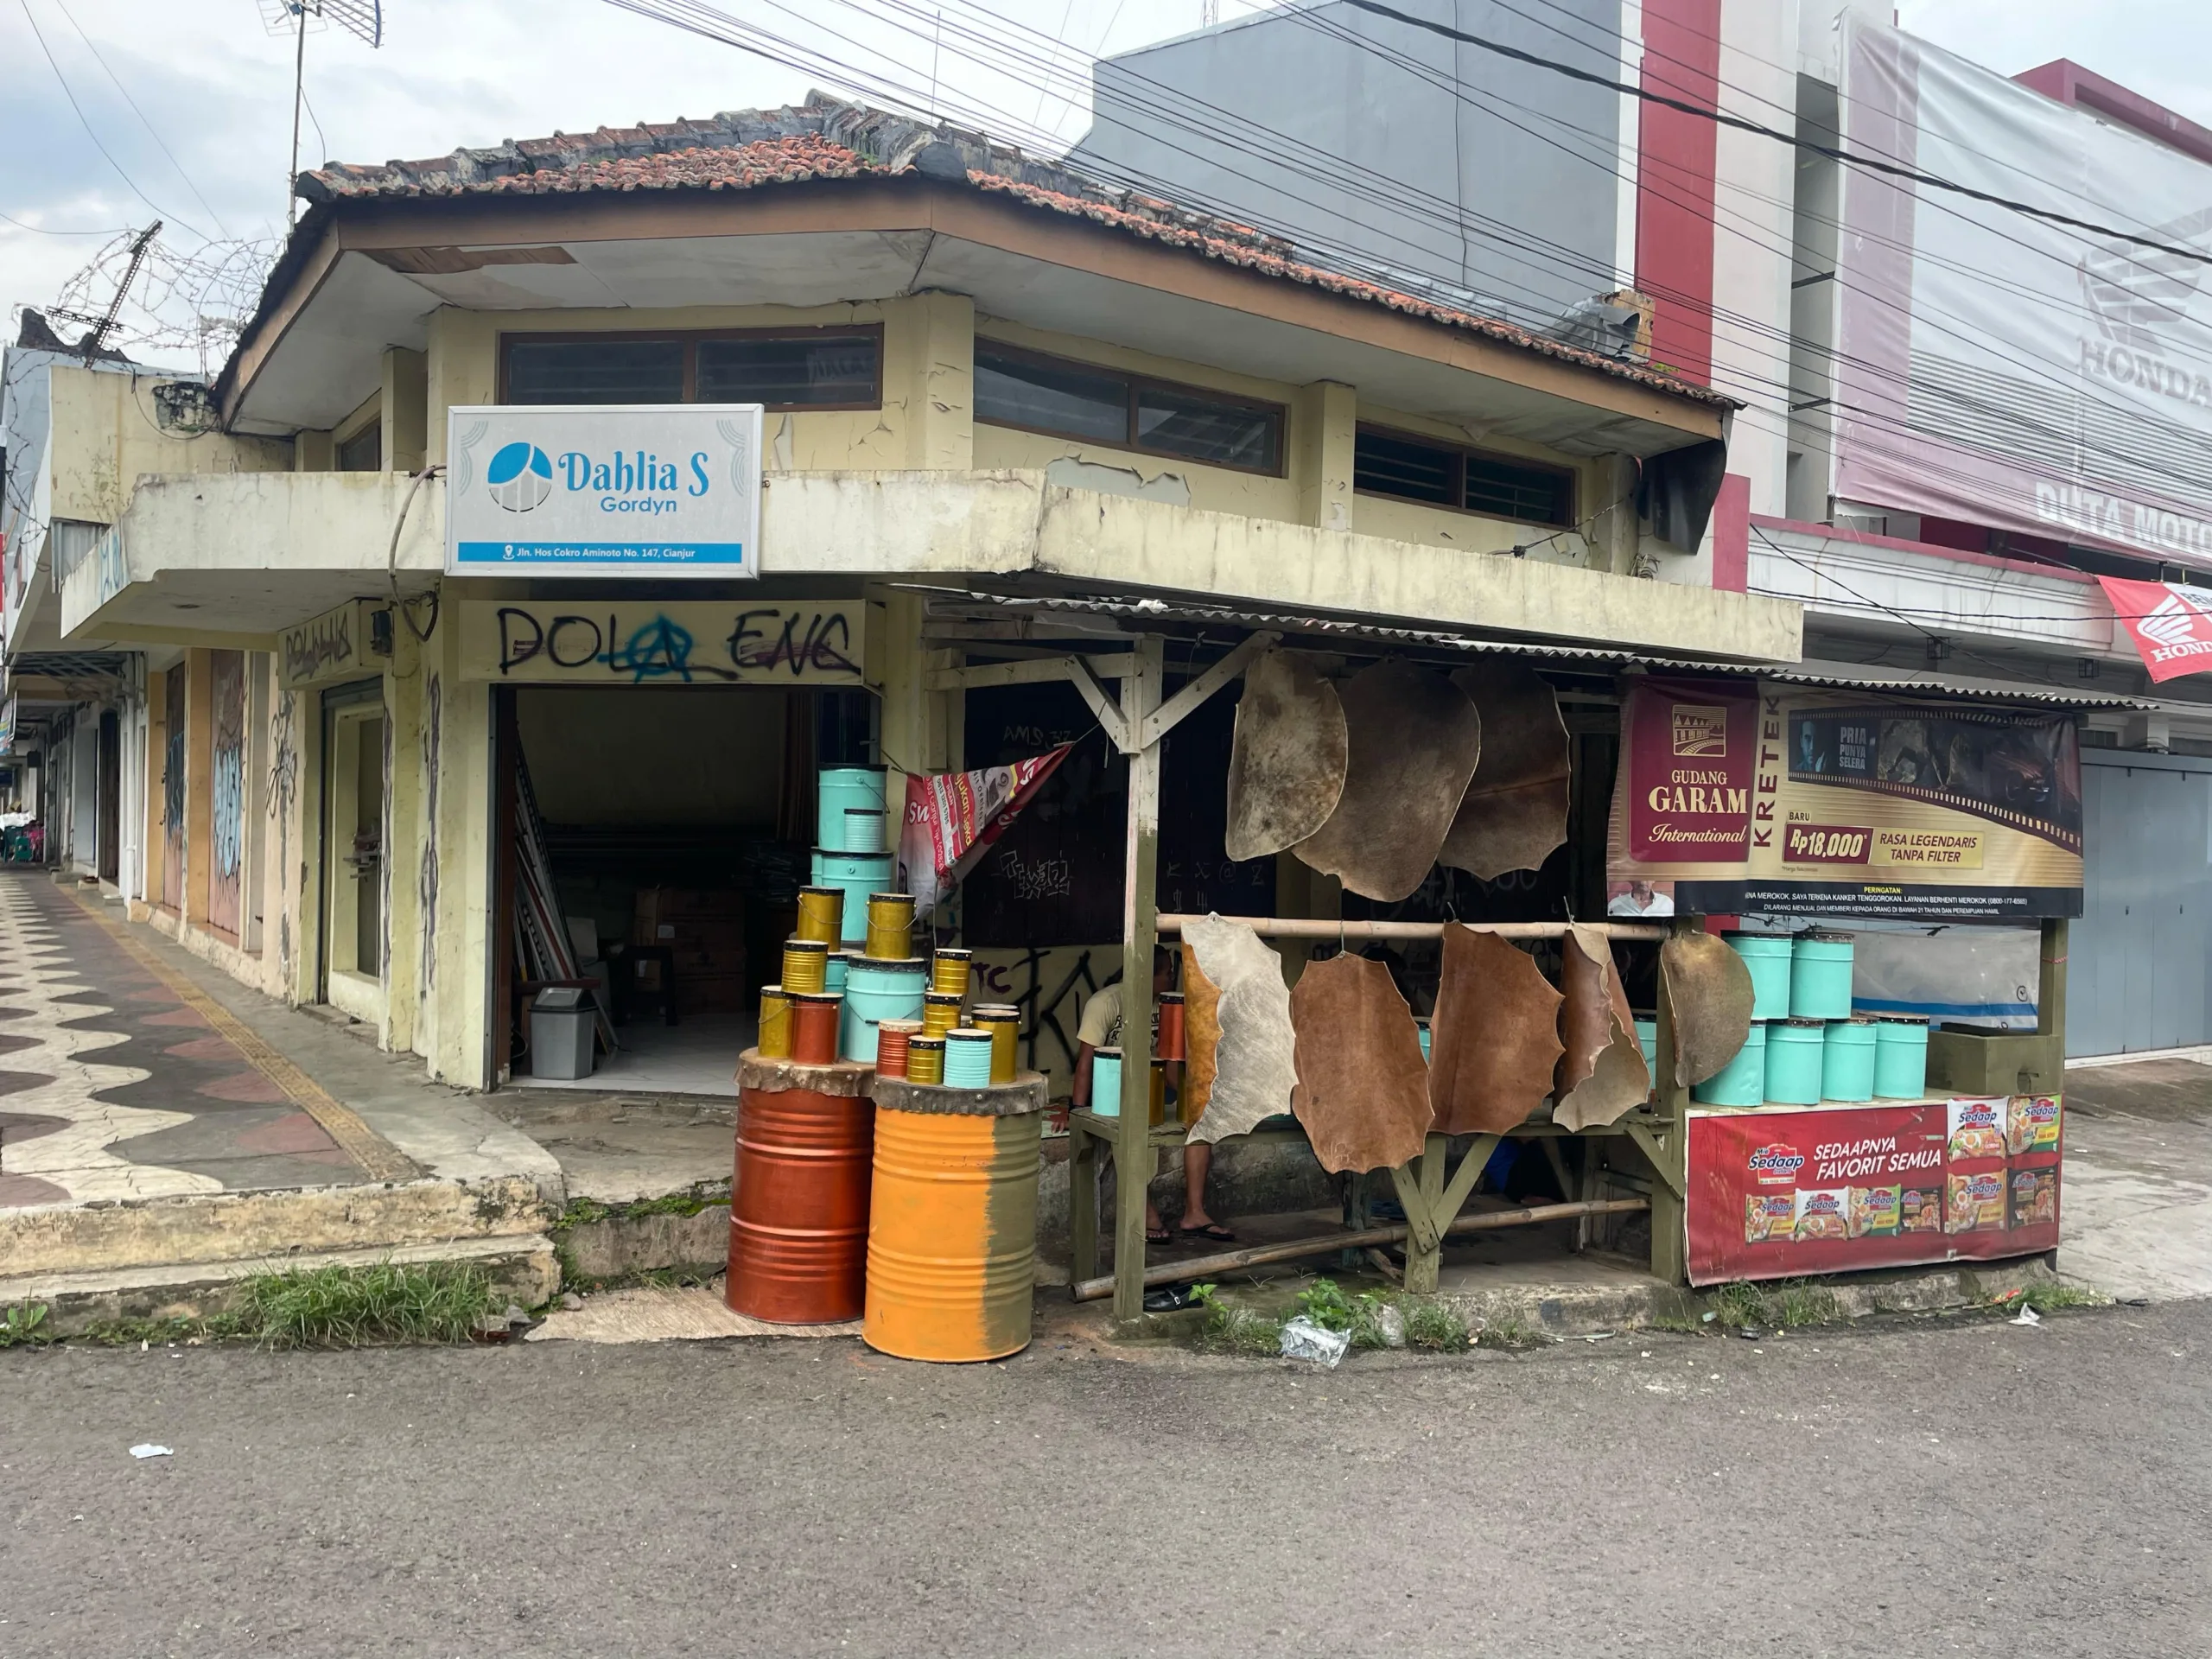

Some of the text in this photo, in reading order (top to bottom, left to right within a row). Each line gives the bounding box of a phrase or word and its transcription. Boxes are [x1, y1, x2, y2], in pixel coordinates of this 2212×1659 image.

[2081, 339, 2212, 406] HONDA
[558, 451, 710, 497] Dahlia S
[600, 496, 677, 516] Gordyn
[2036, 480, 2125, 542] DUTA
[517, 548, 696, 560] Jln. Hos Cokro Aminoto No. 147, Cianjur
[1840, 726, 1866, 745] PRIA
[1840, 744, 1866, 758] PUNYA
[1839, 756, 1866, 770] SELERA
[1671, 769, 1728, 785] GUDANG
[1753, 695, 1780, 848] KRETEK
[1649, 786, 1749, 814] GARAM
[1789, 811, 1810, 822] BARU
[1649, 823, 1747, 843] International
[1880, 833, 1977, 849] RASA LEGENDARIS
[1891, 849, 1961, 862] TANPA FILTER
[1758, 892, 1790, 900] MEROKOK,
[1958, 1109, 1998, 1123] Sedaap
[2024, 1104, 2059, 1117] Sedaap
[1814, 1136, 1896, 1161] SEDAAPNYA
[1748, 1154, 1804, 1171] Sedaap
[1816, 1148, 1942, 1181] FAVORIT SEMUA
[1967, 1182, 2002, 1195] Sedaap
[1762, 1203, 1795, 1212] Sedaap
[1805, 1198, 1840, 1211] Sedaap
[1864, 1196, 1897, 1205] Sedaap
